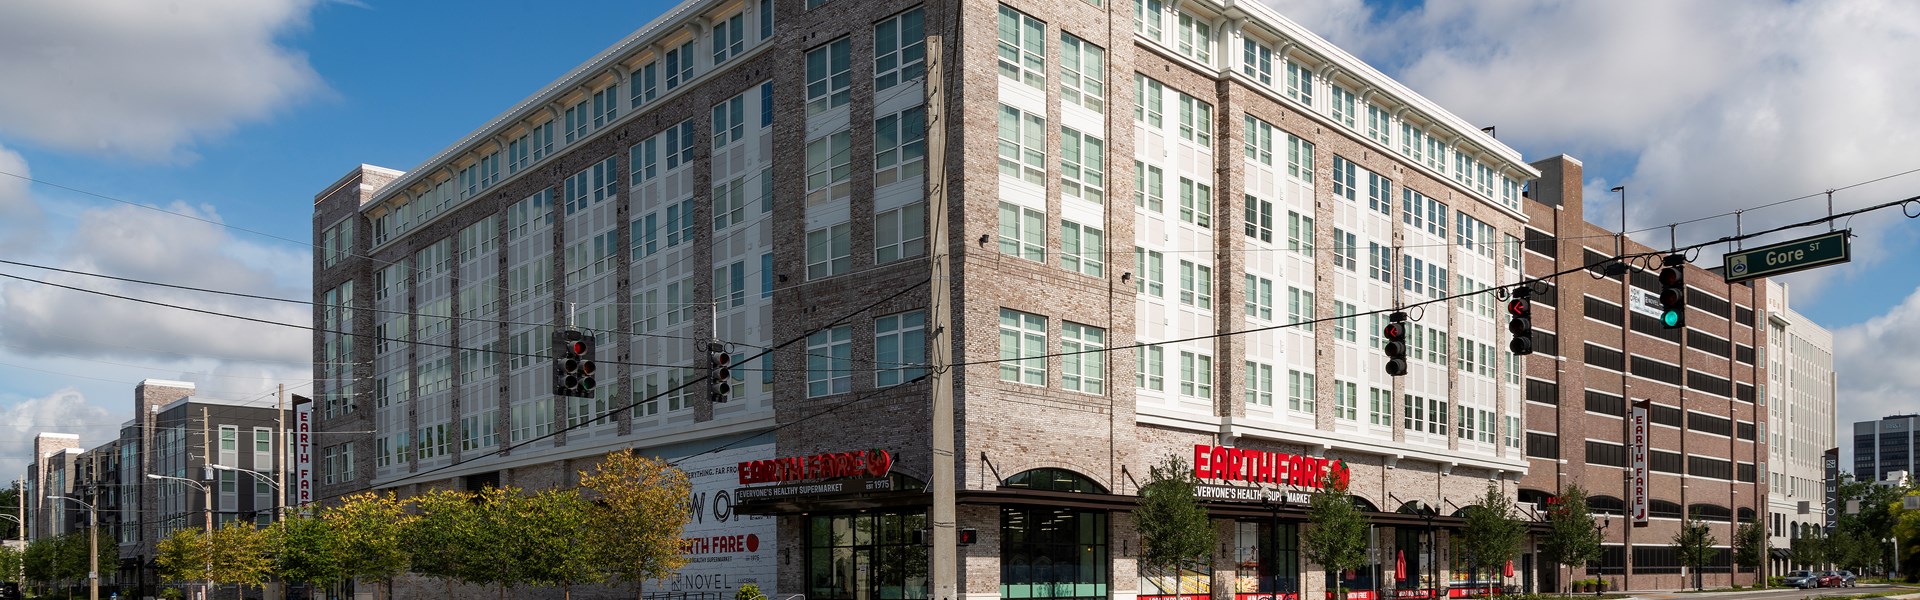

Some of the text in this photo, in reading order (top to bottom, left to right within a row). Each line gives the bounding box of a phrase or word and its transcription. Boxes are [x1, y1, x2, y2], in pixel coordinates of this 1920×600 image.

[1766, 242, 1820, 266] Gore ST
[300, 412, 309, 463] EARTH
[726, 466, 738, 474] FRO
[738, 450, 865, 485] EARTH FARE
[1194, 444, 1330, 489] EARTH FARE
[1635, 416, 1644, 505] EARTH FARE
[739, 483, 843, 498] EVERYONE'S HEALTHY SUPERMARKET
[874, 480, 890, 489] 1975
[1237, 488, 1262, 500] HEALTH
[1268, 490, 1311, 504] SUPMARKET
[1827, 474, 1836, 528] NOVEL
[712, 535, 744, 554] FARE
[685, 573, 732, 590] NOVEL
